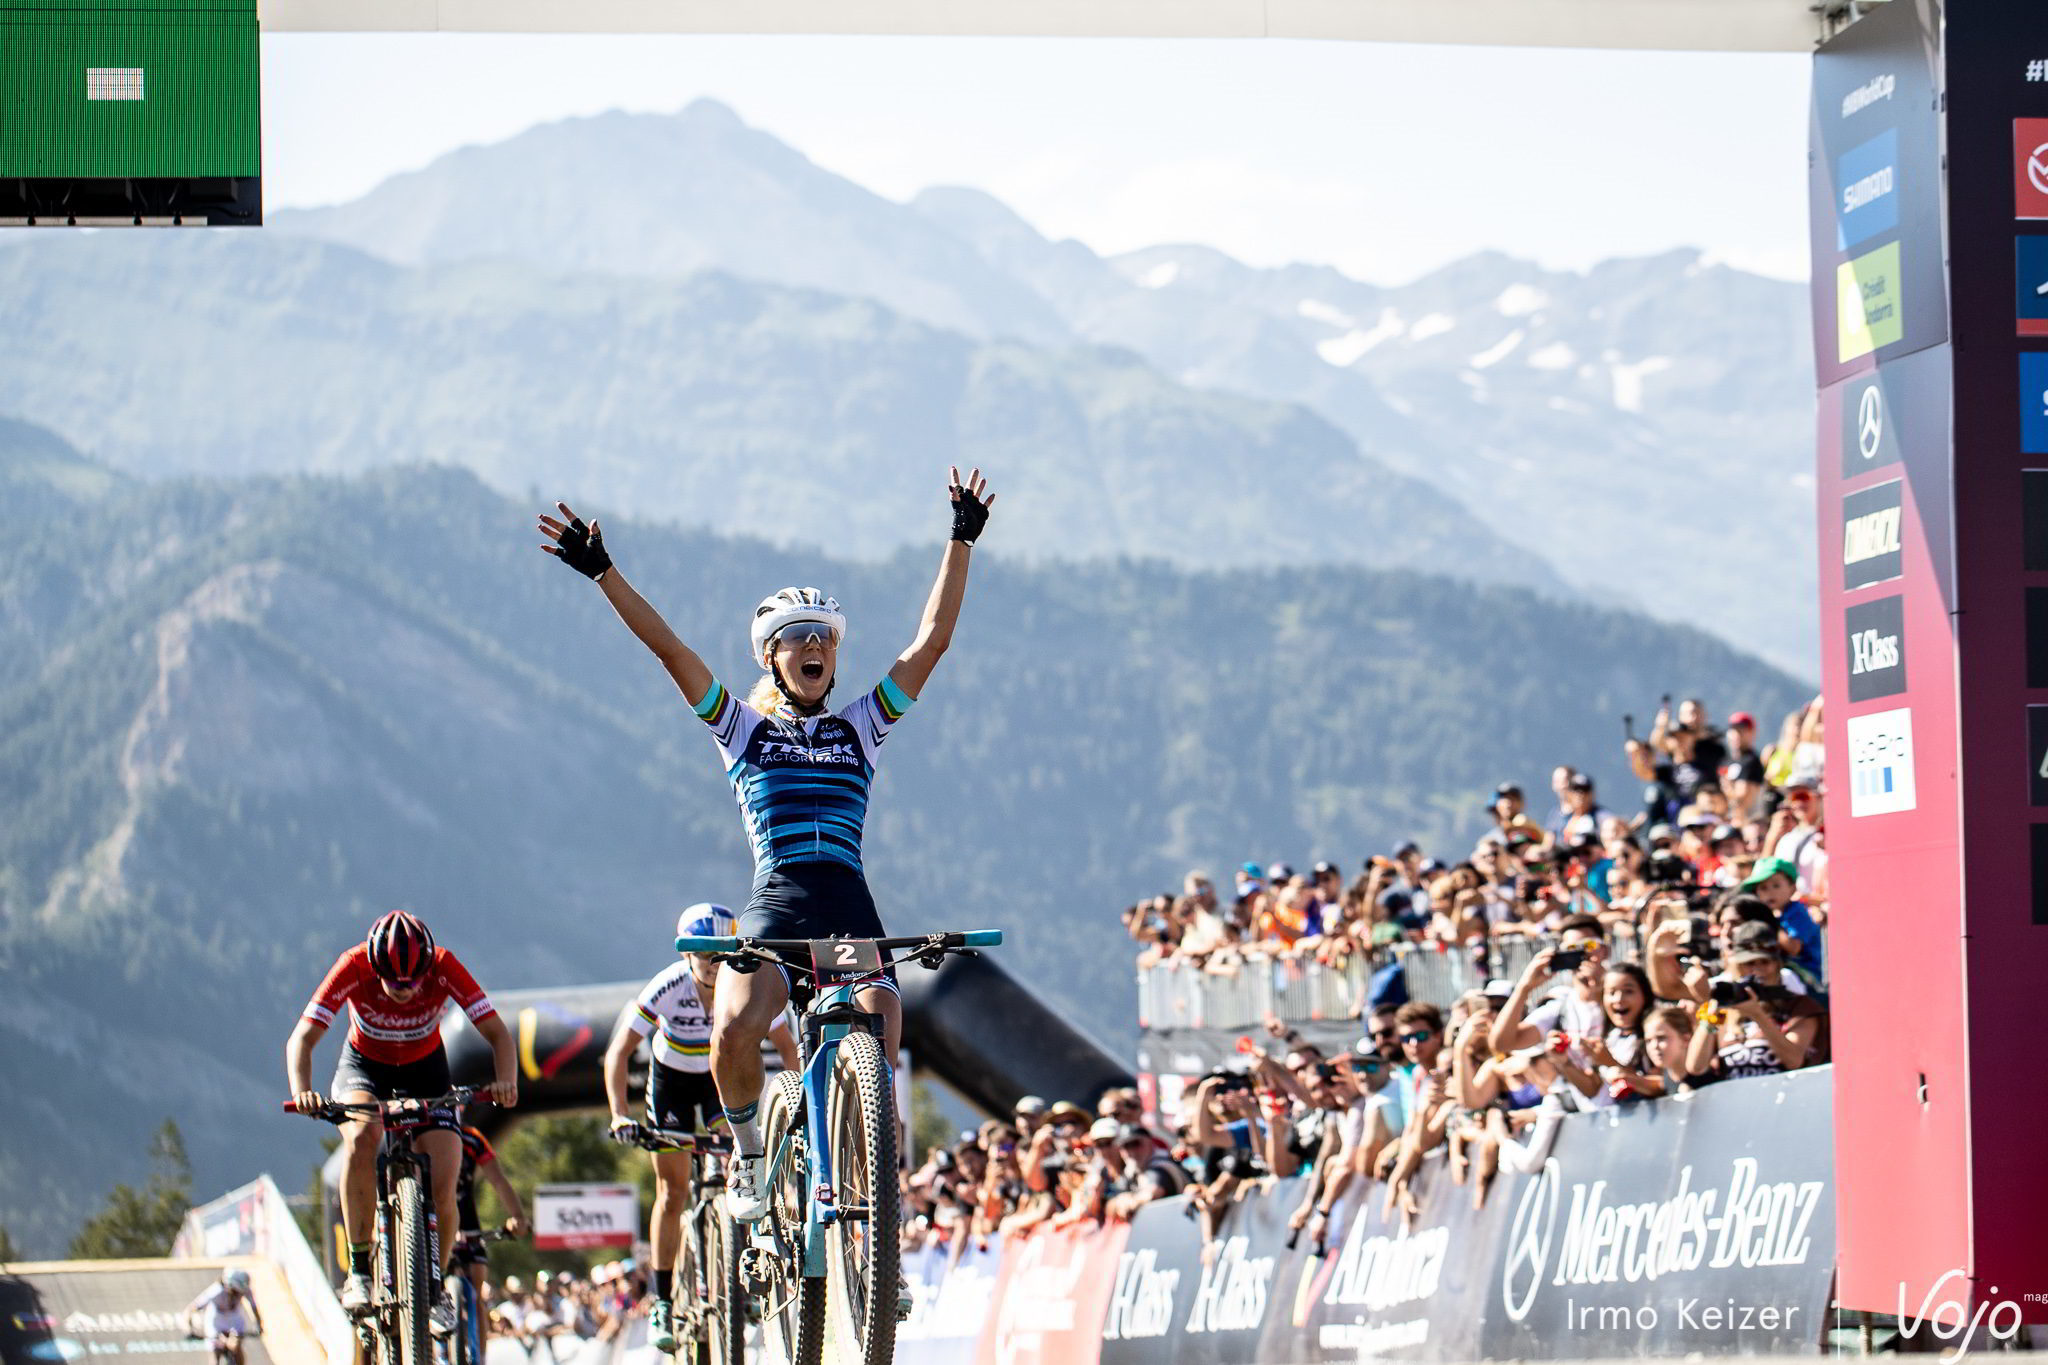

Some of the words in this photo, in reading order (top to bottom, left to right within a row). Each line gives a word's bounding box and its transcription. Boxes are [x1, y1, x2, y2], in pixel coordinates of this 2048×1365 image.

[1844, 166, 1893, 214] SHIMANO
[1851, 628, 1899, 675] X-Class
[758, 740, 856, 757] TREK
[815, 755, 859, 766] RACING
[834, 944, 858, 966] 2
[1552, 1157, 1824, 1286] Mercedes-Benz
